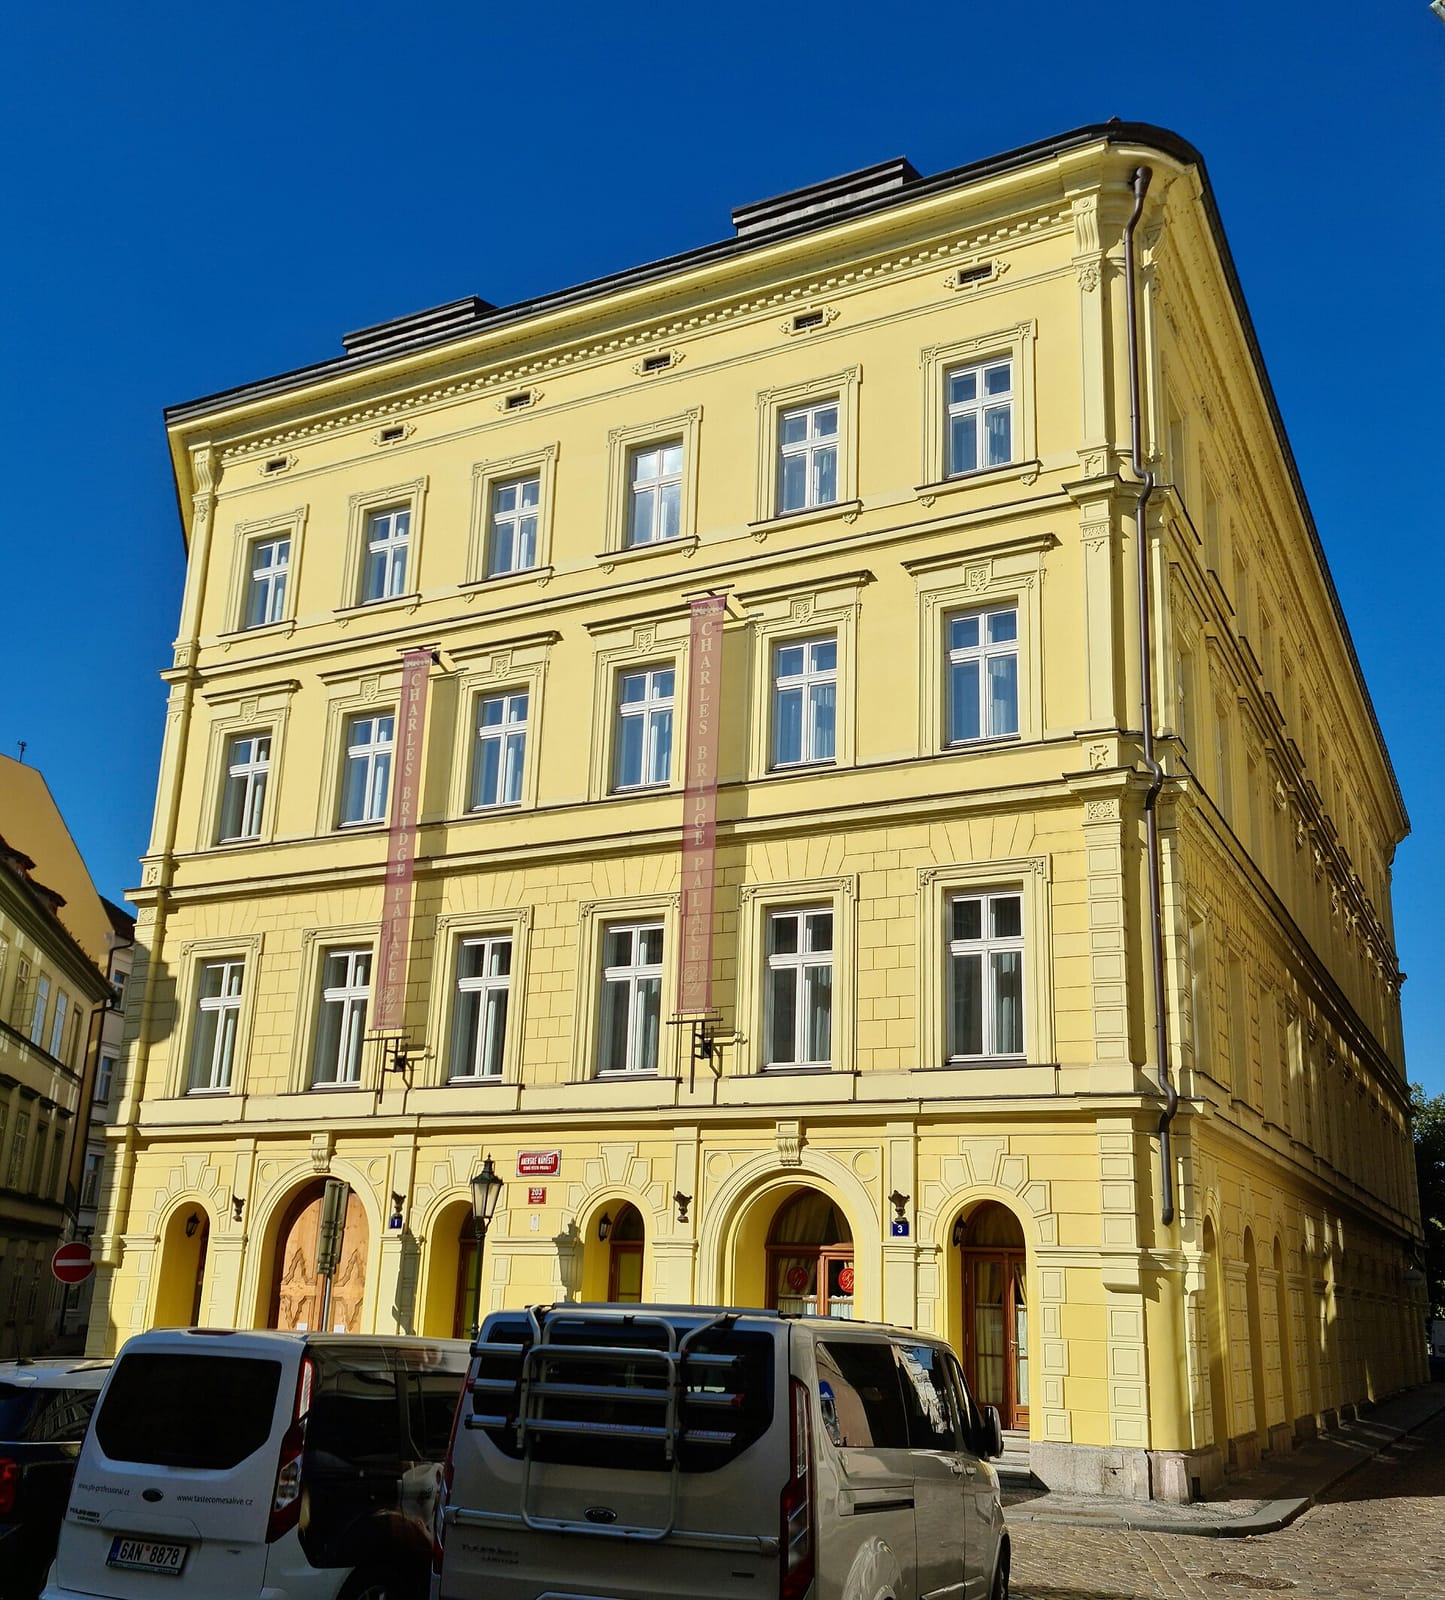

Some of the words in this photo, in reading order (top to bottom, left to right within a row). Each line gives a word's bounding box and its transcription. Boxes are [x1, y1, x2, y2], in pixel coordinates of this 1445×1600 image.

[699, 621, 713, 735] CHARLES
[404, 673, 421, 777] CHARLES
[397, 787, 412, 877] BRIDGE
[694, 745, 708, 846] BRIDGE
[388, 887, 403, 980] PALACE
[690, 857, 704, 961] PALACE
[897, 1224, 903, 1234] 3
[176, 1495, 254, 1506] www.tastecomesalive.cz
[120, 1542, 144, 1561] 6AN
[149, 1546, 180, 1565] 8878
